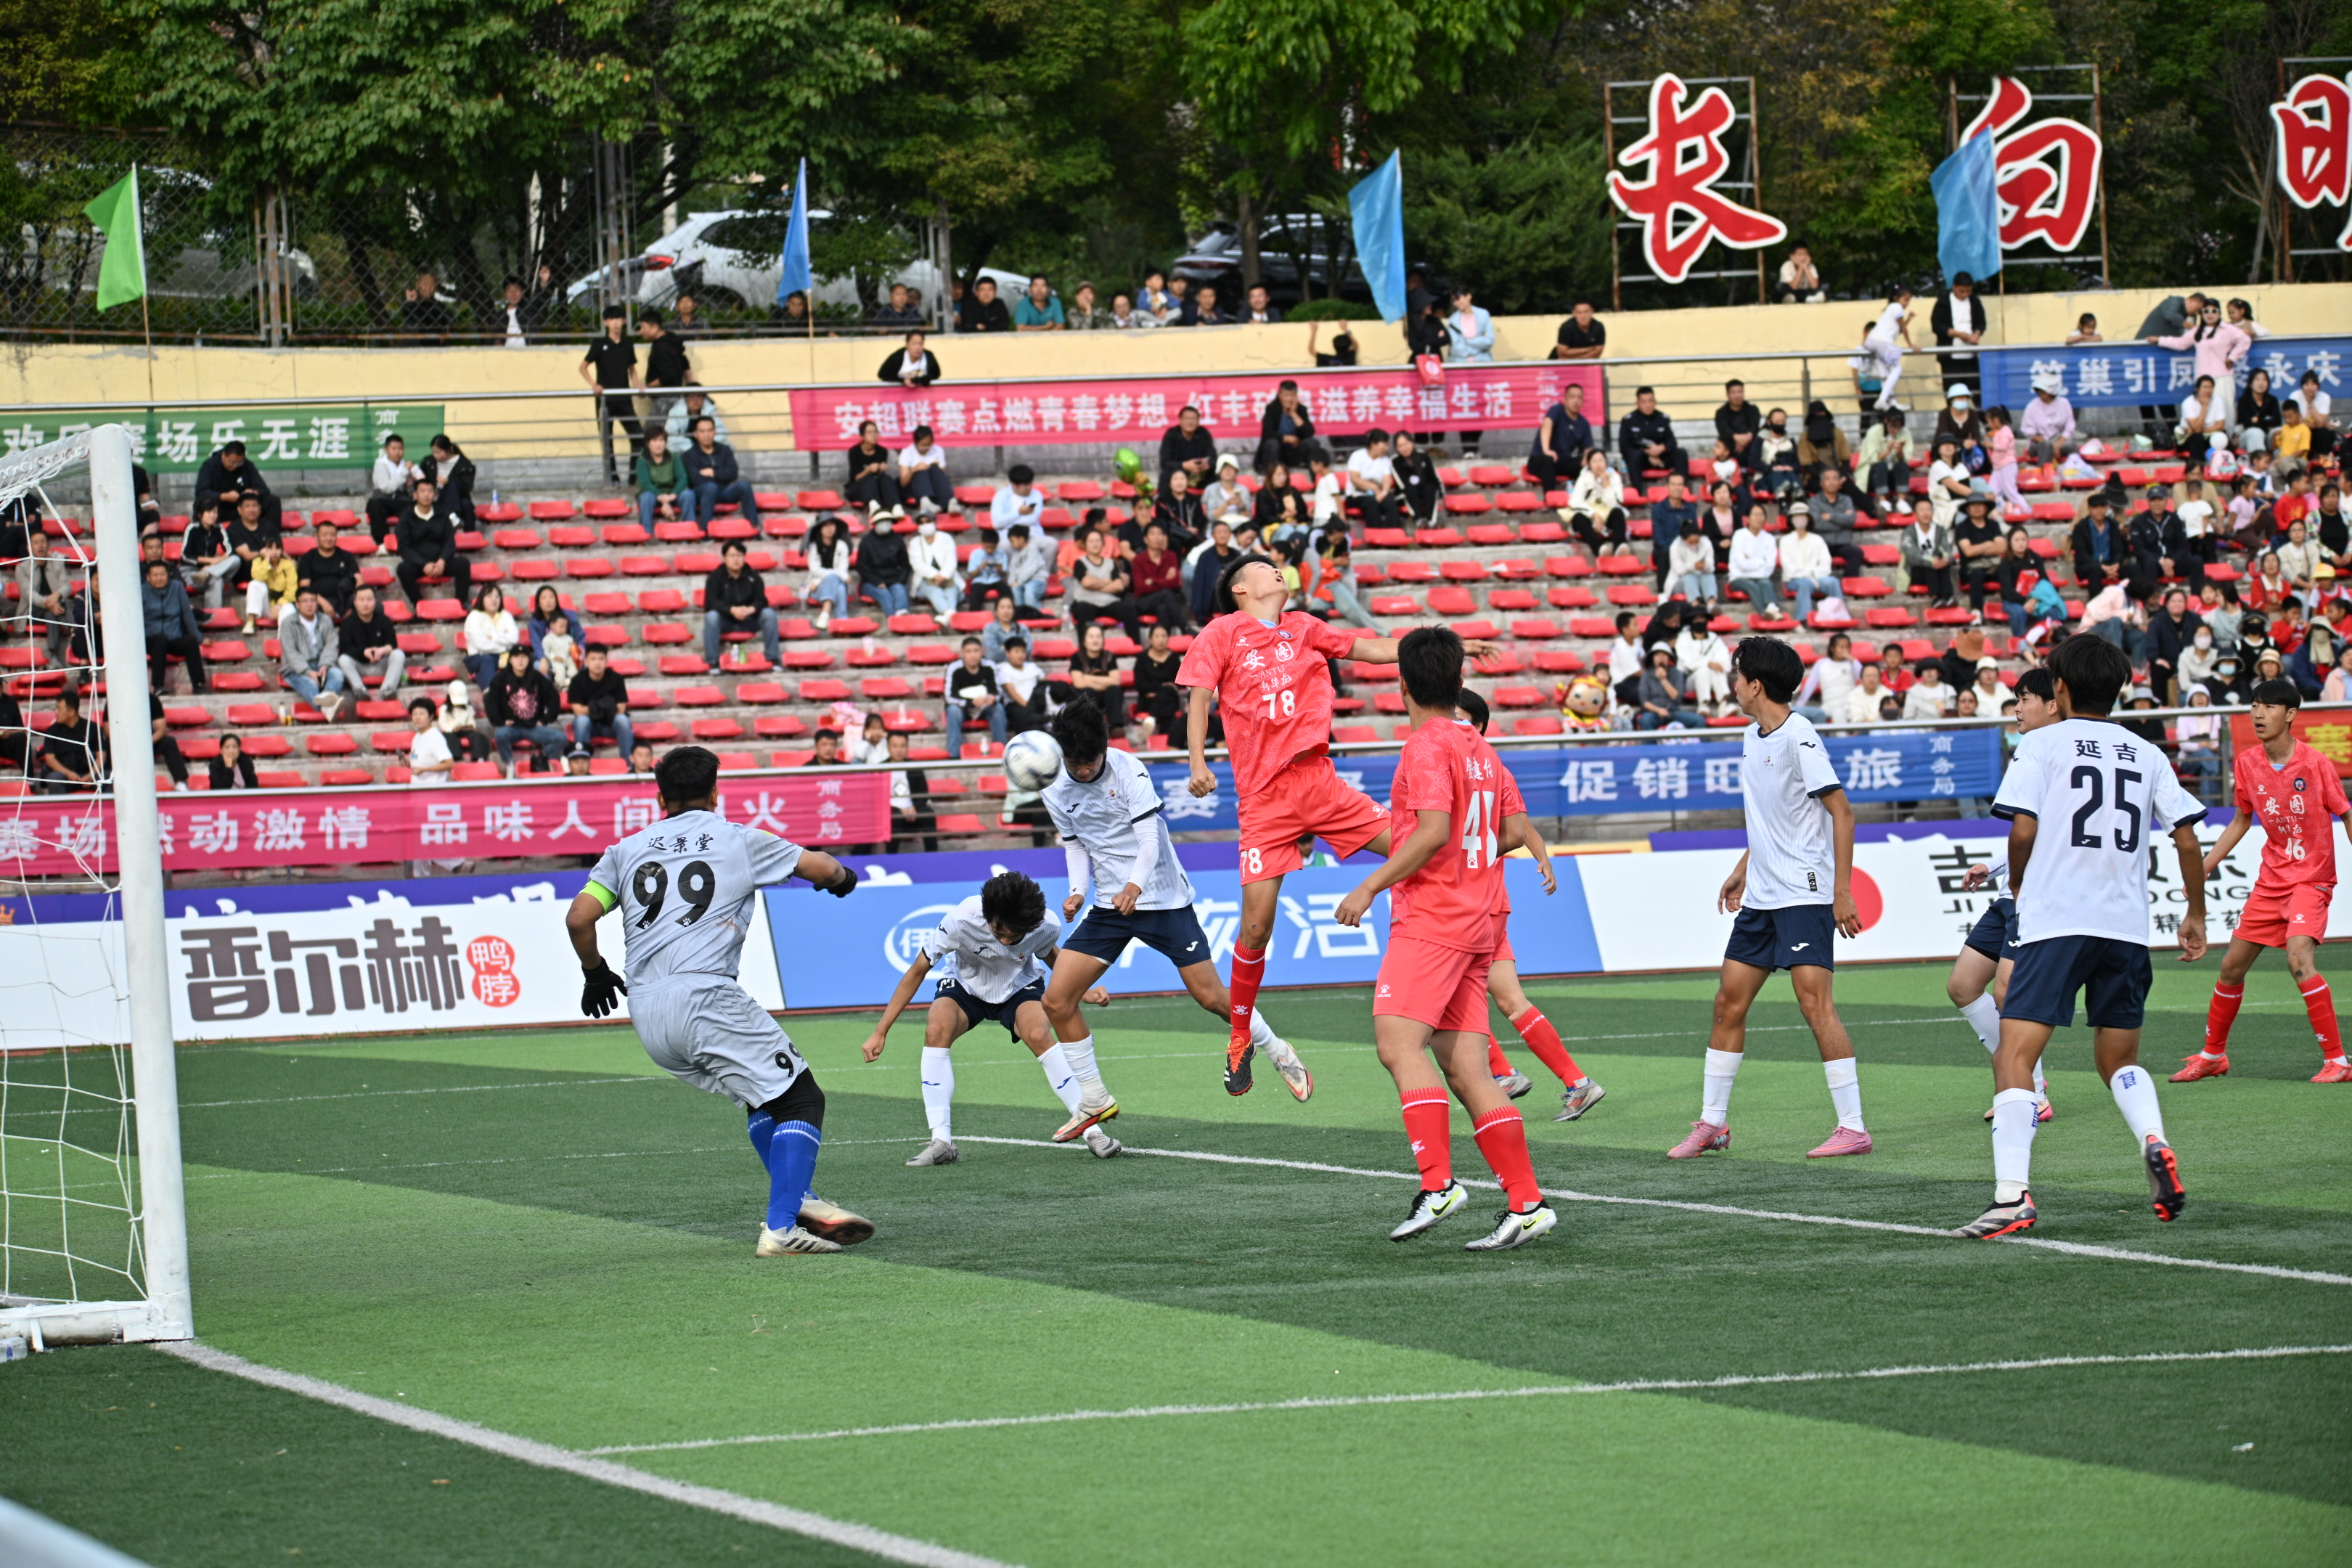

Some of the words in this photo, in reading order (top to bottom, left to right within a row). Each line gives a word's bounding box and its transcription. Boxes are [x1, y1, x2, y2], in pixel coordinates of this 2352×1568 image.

[1243, 641, 1294, 669] 安图
[1262, 690, 1296, 719] 78
[1930, 735, 1955, 796] 商务局
[2075, 740, 2137, 763] 延吉
[1561, 748, 1903, 803] 促销旺旅
[420, 791, 788, 845] 品味人间火
[816, 780, 844, 840] 商务局
[2071, 765, 2142, 853] 25
[2263, 794, 2305, 815] 安图
[648, 833, 714, 853] 迟景堂
[1241, 848, 1263, 877] 78
[2285, 838, 2306, 860] 46
[633, 860, 716, 930] 99
[470, 939, 516, 1003] 鸭脖
